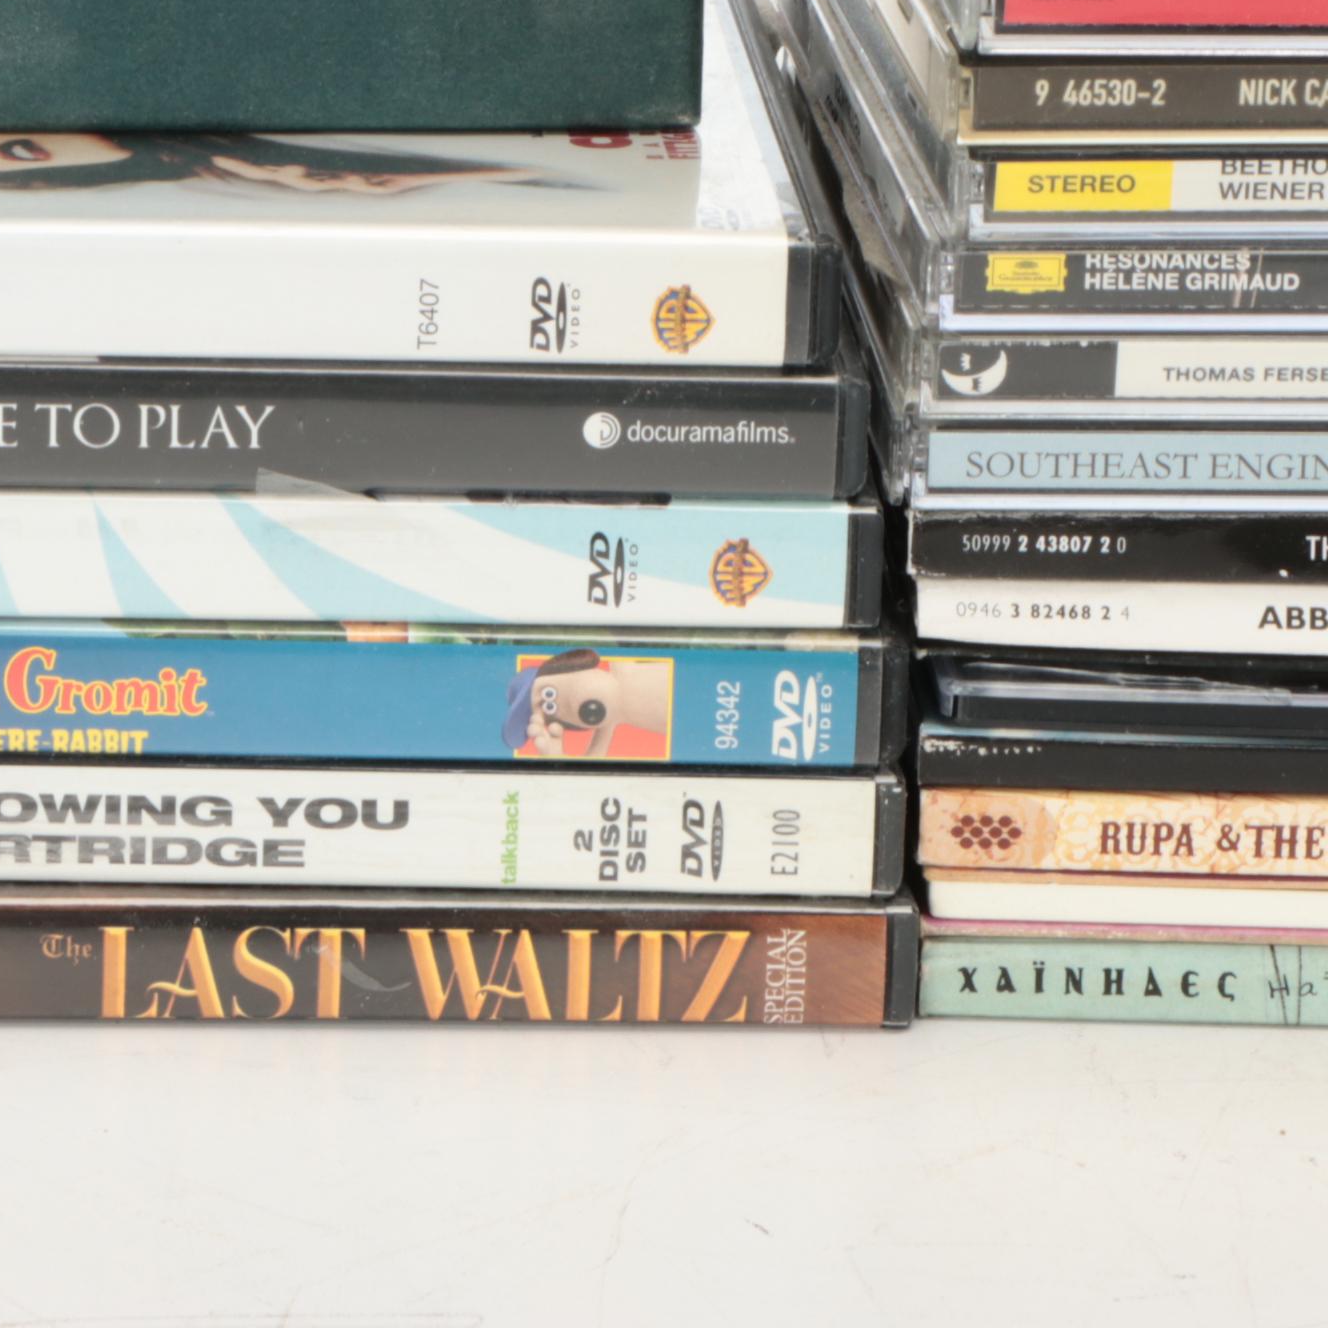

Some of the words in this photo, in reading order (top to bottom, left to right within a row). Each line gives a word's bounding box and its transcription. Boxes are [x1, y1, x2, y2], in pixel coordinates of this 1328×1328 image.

[1035, 78, 1050, 107] 9
[1062, 78, 1167, 108] 46530-2
[1238, 78, 1297, 107] NICK
[1027, 174, 1137, 194] STEREO
[1218, 181, 1325, 201] WIENER
[1084, 252, 1251, 270] RESONANCES
[1185, 272, 1301, 291] GRIMAUD
[417, 277, 440, 350] T6407
[529, 276, 555, 353] DVD
[569, 288, 581, 349] VIDEO
[1162, 366, 1256, 383] THOMAS
[34, 403, 121, 450] TO
[137, 403, 276, 450] PLAY
[965, 450, 1198, 480] SOUTHEAST
[587, 531, 612, 607] DVD
[627, 543, 639, 603] VIDEO
[962, 534, 1011, 553] 50999
[1018, 534, 1028, 553] 2
[1035, 534, 1093, 554] 43807
[1100, 535, 1111, 554] 2
[1116, 536, 1127, 554] 0
[956, 601, 1002, 618] 0946
[1011, 602, 1020, 618] 3
[1030, 603, 1092, 619] 82468
[1101, 605, 1111, 621] 2
[1120, 606, 1130, 621] 4
[4, 645, 209, 718] Gromit
[714, 680, 741, 750] 94342
[771, 669, 802, 760] DVD
[818, 683, 833, 754] VIDEO
[258, 796, 410, 831] YOU
[501, 790, 520, 885] talkback
[573, 829, 593, 852] 2
[598, 797, 621, 882] DISC
[625, 807, 648, 874] SET
[680, 798, 708, 878] DVD
[770, 808, 801, 876] E2100
[1099, 821, 1195, 857] RUPA
[39, 933, 93, 967] The
[98, 925, 366, 1020] LAST
[399, 928, 751, 1022] WALTZ
[764, 928, 787, 1024] SPECIAL
[784, 928, 806, 1024] EDITION
